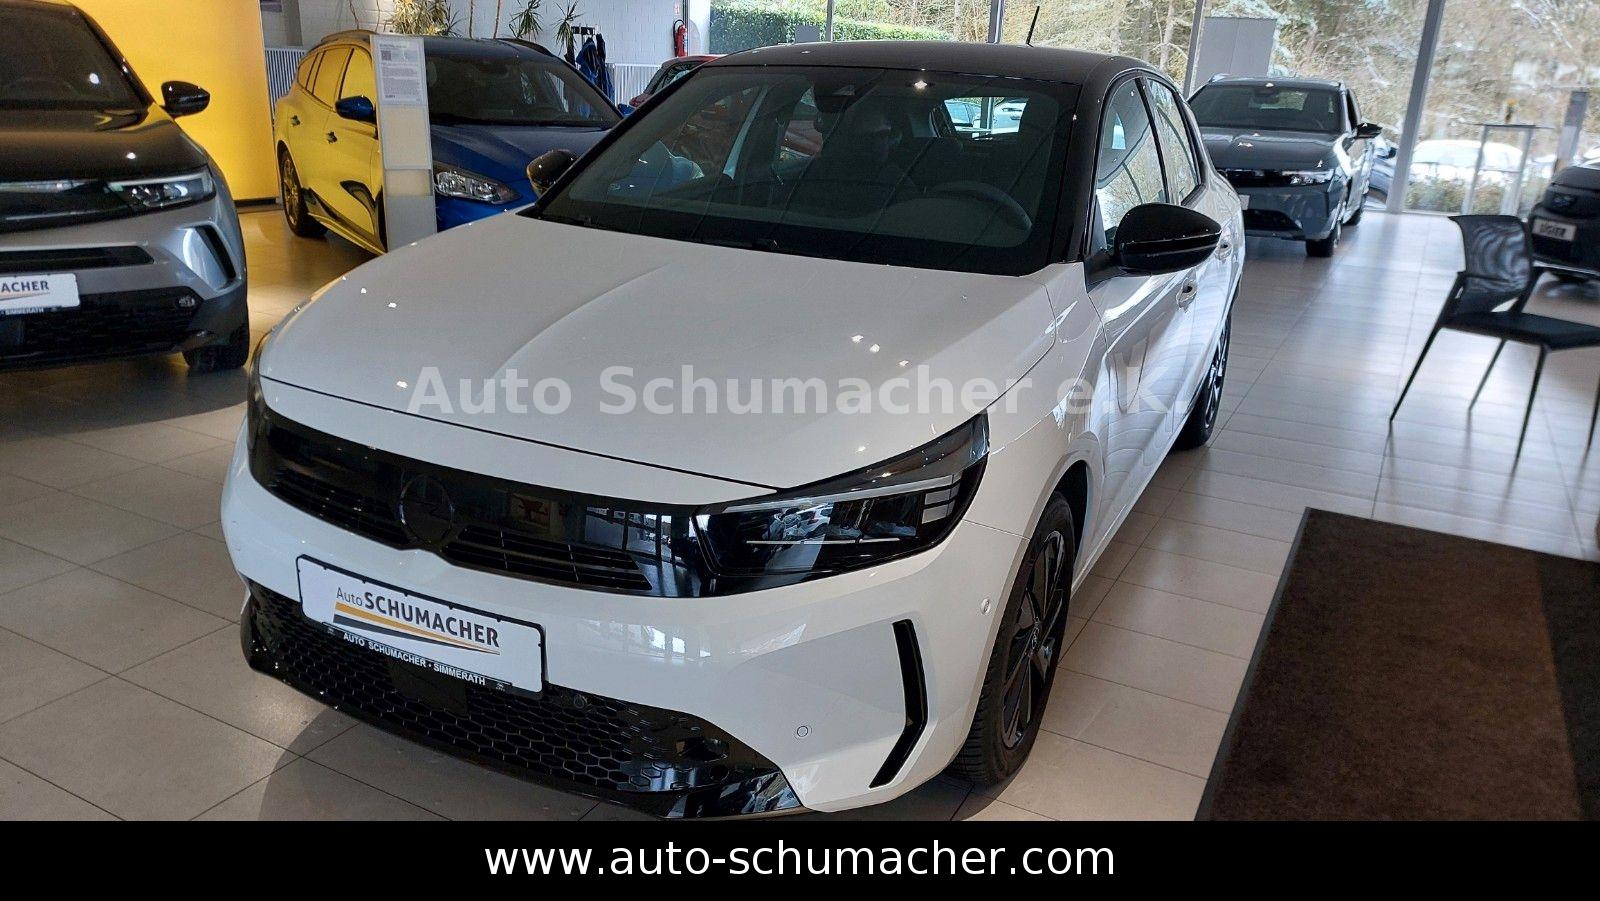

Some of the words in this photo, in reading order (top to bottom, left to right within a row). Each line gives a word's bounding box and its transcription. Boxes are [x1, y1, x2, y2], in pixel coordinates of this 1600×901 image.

[336, 586, 363, 606] Auto
[363, 591, 500, 648] SCHUMACHER
[343, 632, 366, 648] AUTO
[368, 640, 428, 668] SCHUMACHER
[433, 661, 487, 686] SIMMERATH
